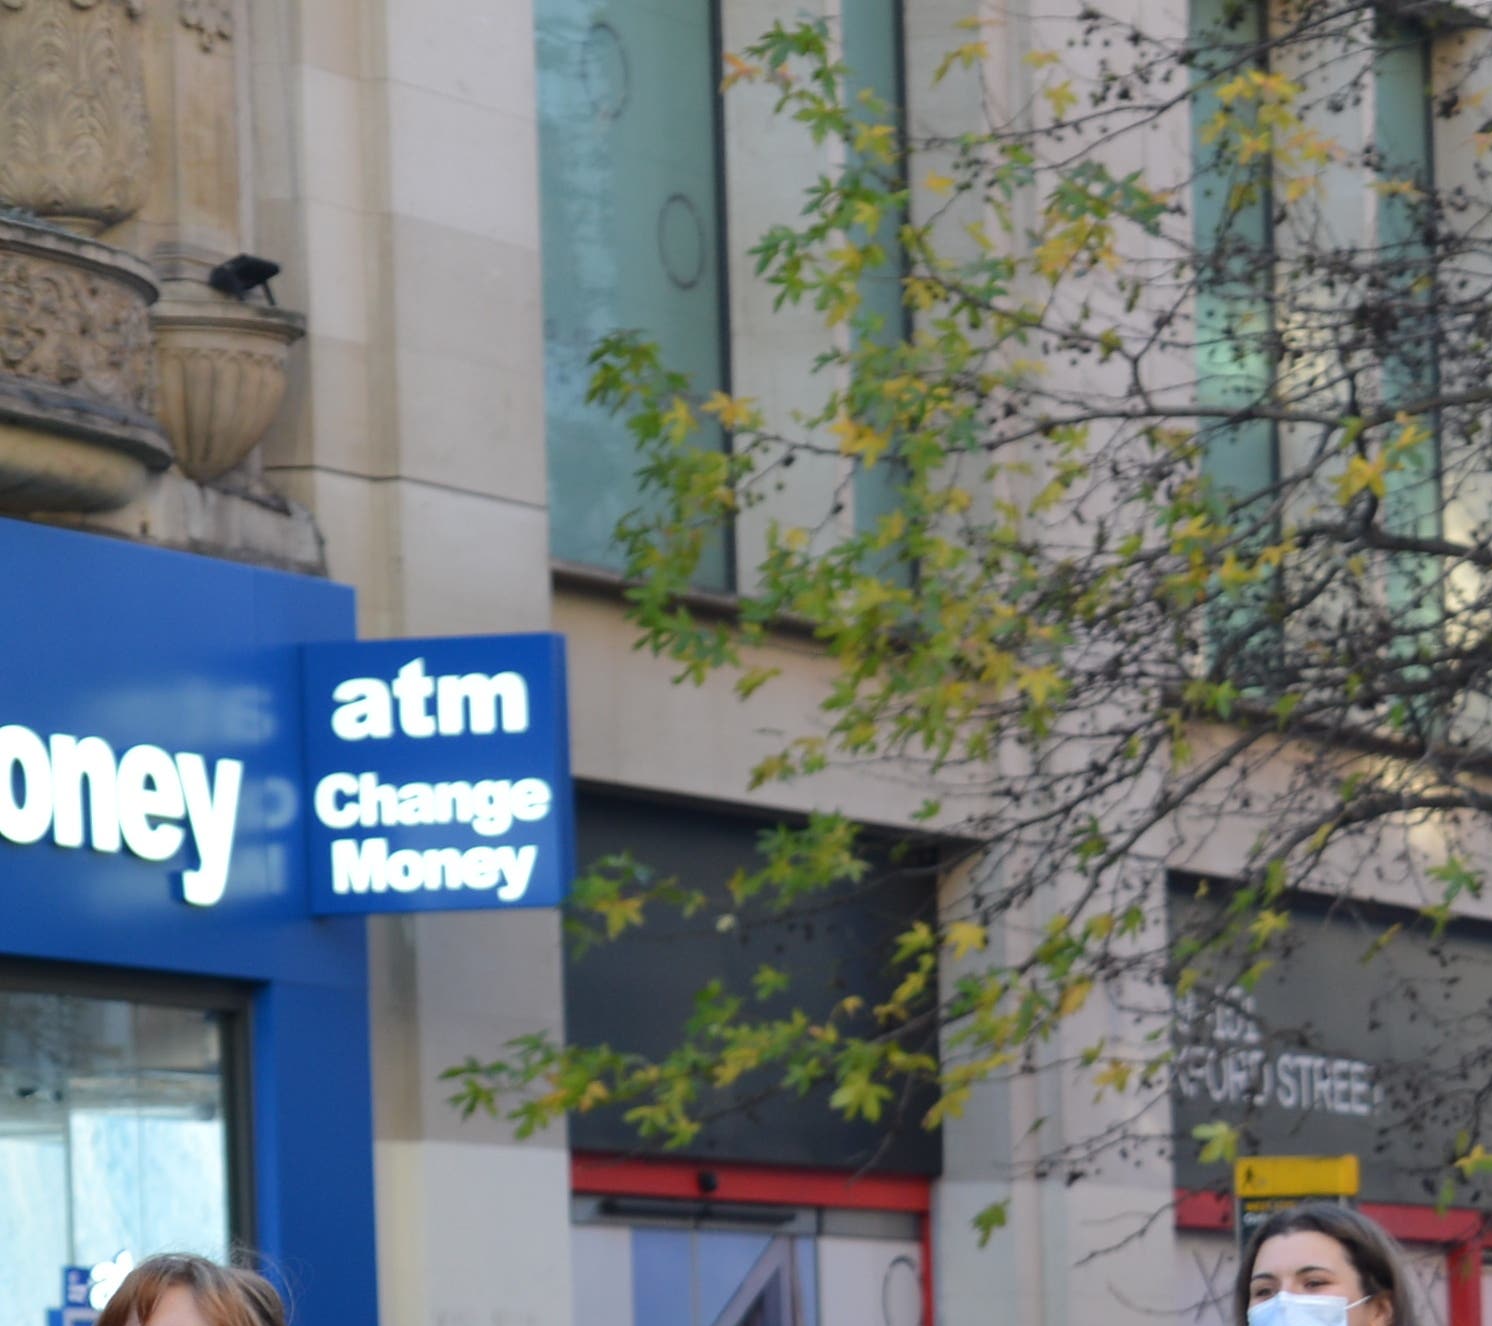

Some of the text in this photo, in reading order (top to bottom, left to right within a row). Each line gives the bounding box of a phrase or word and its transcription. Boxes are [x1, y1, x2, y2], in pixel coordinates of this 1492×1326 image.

[330, 657, 529, 741] atm
[314, 772, 552, 835] Change
[330, 838, 538, 902] Money
